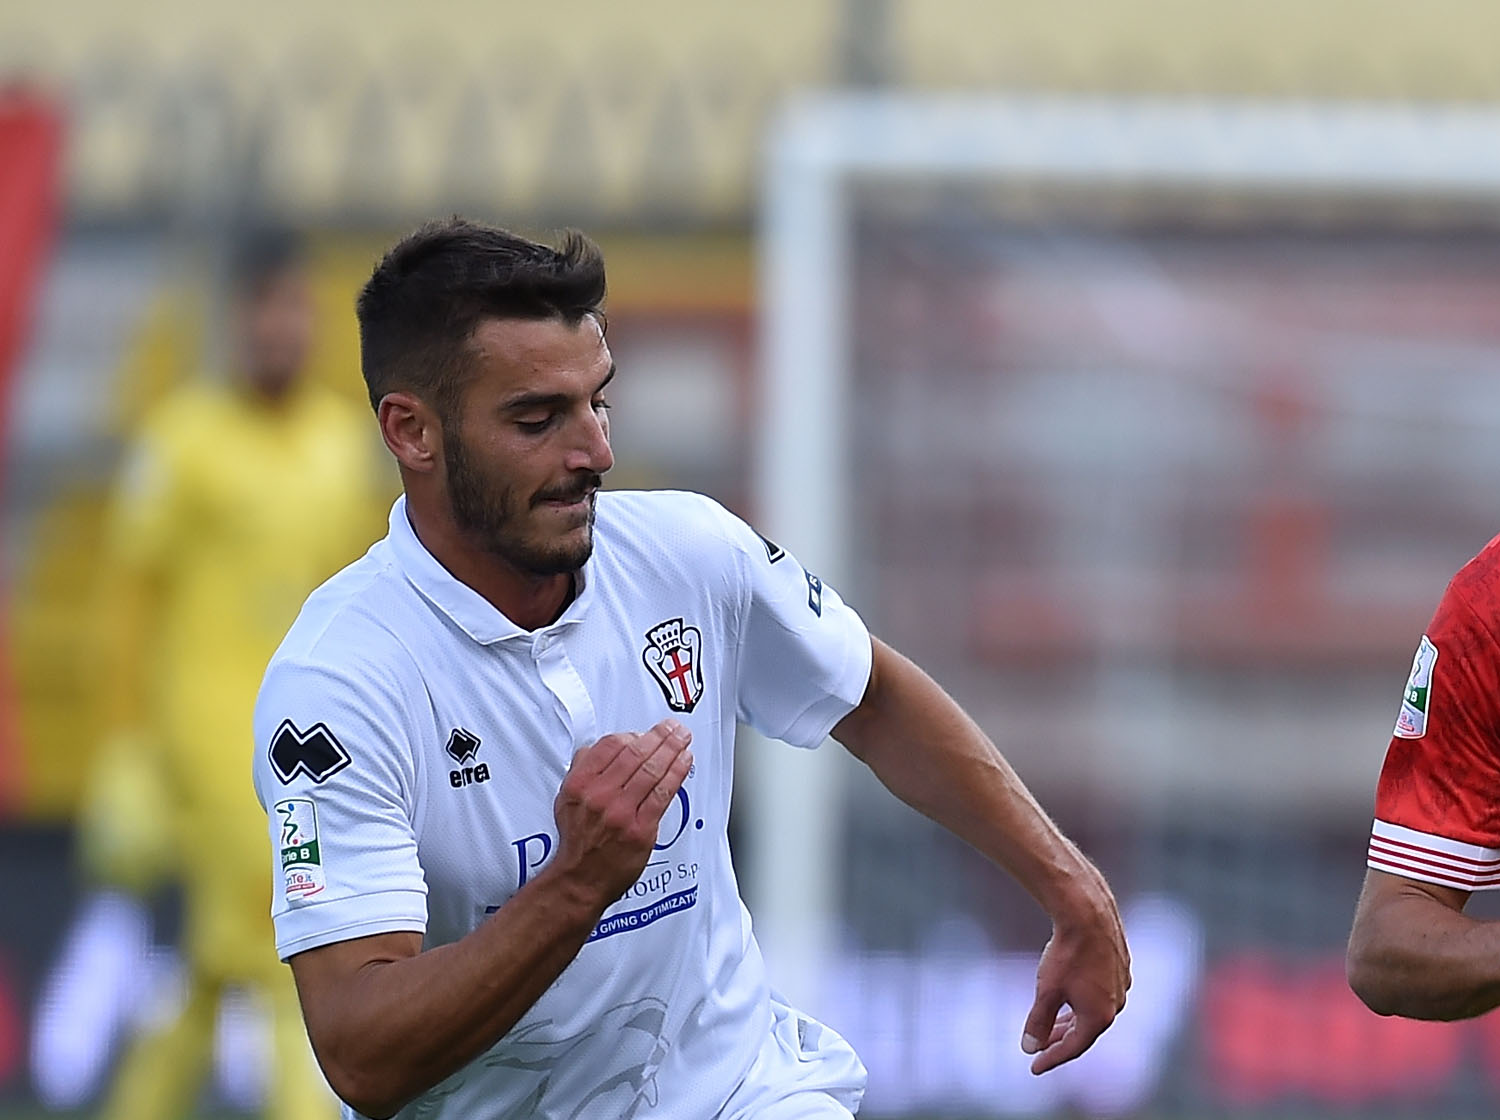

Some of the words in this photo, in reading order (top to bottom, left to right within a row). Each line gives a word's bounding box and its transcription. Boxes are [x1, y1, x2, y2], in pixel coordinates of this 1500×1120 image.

[300, 847, 311, 860] B
[624, 869, 673, 900] roup
[599, 914, 638, 935] GIVING
